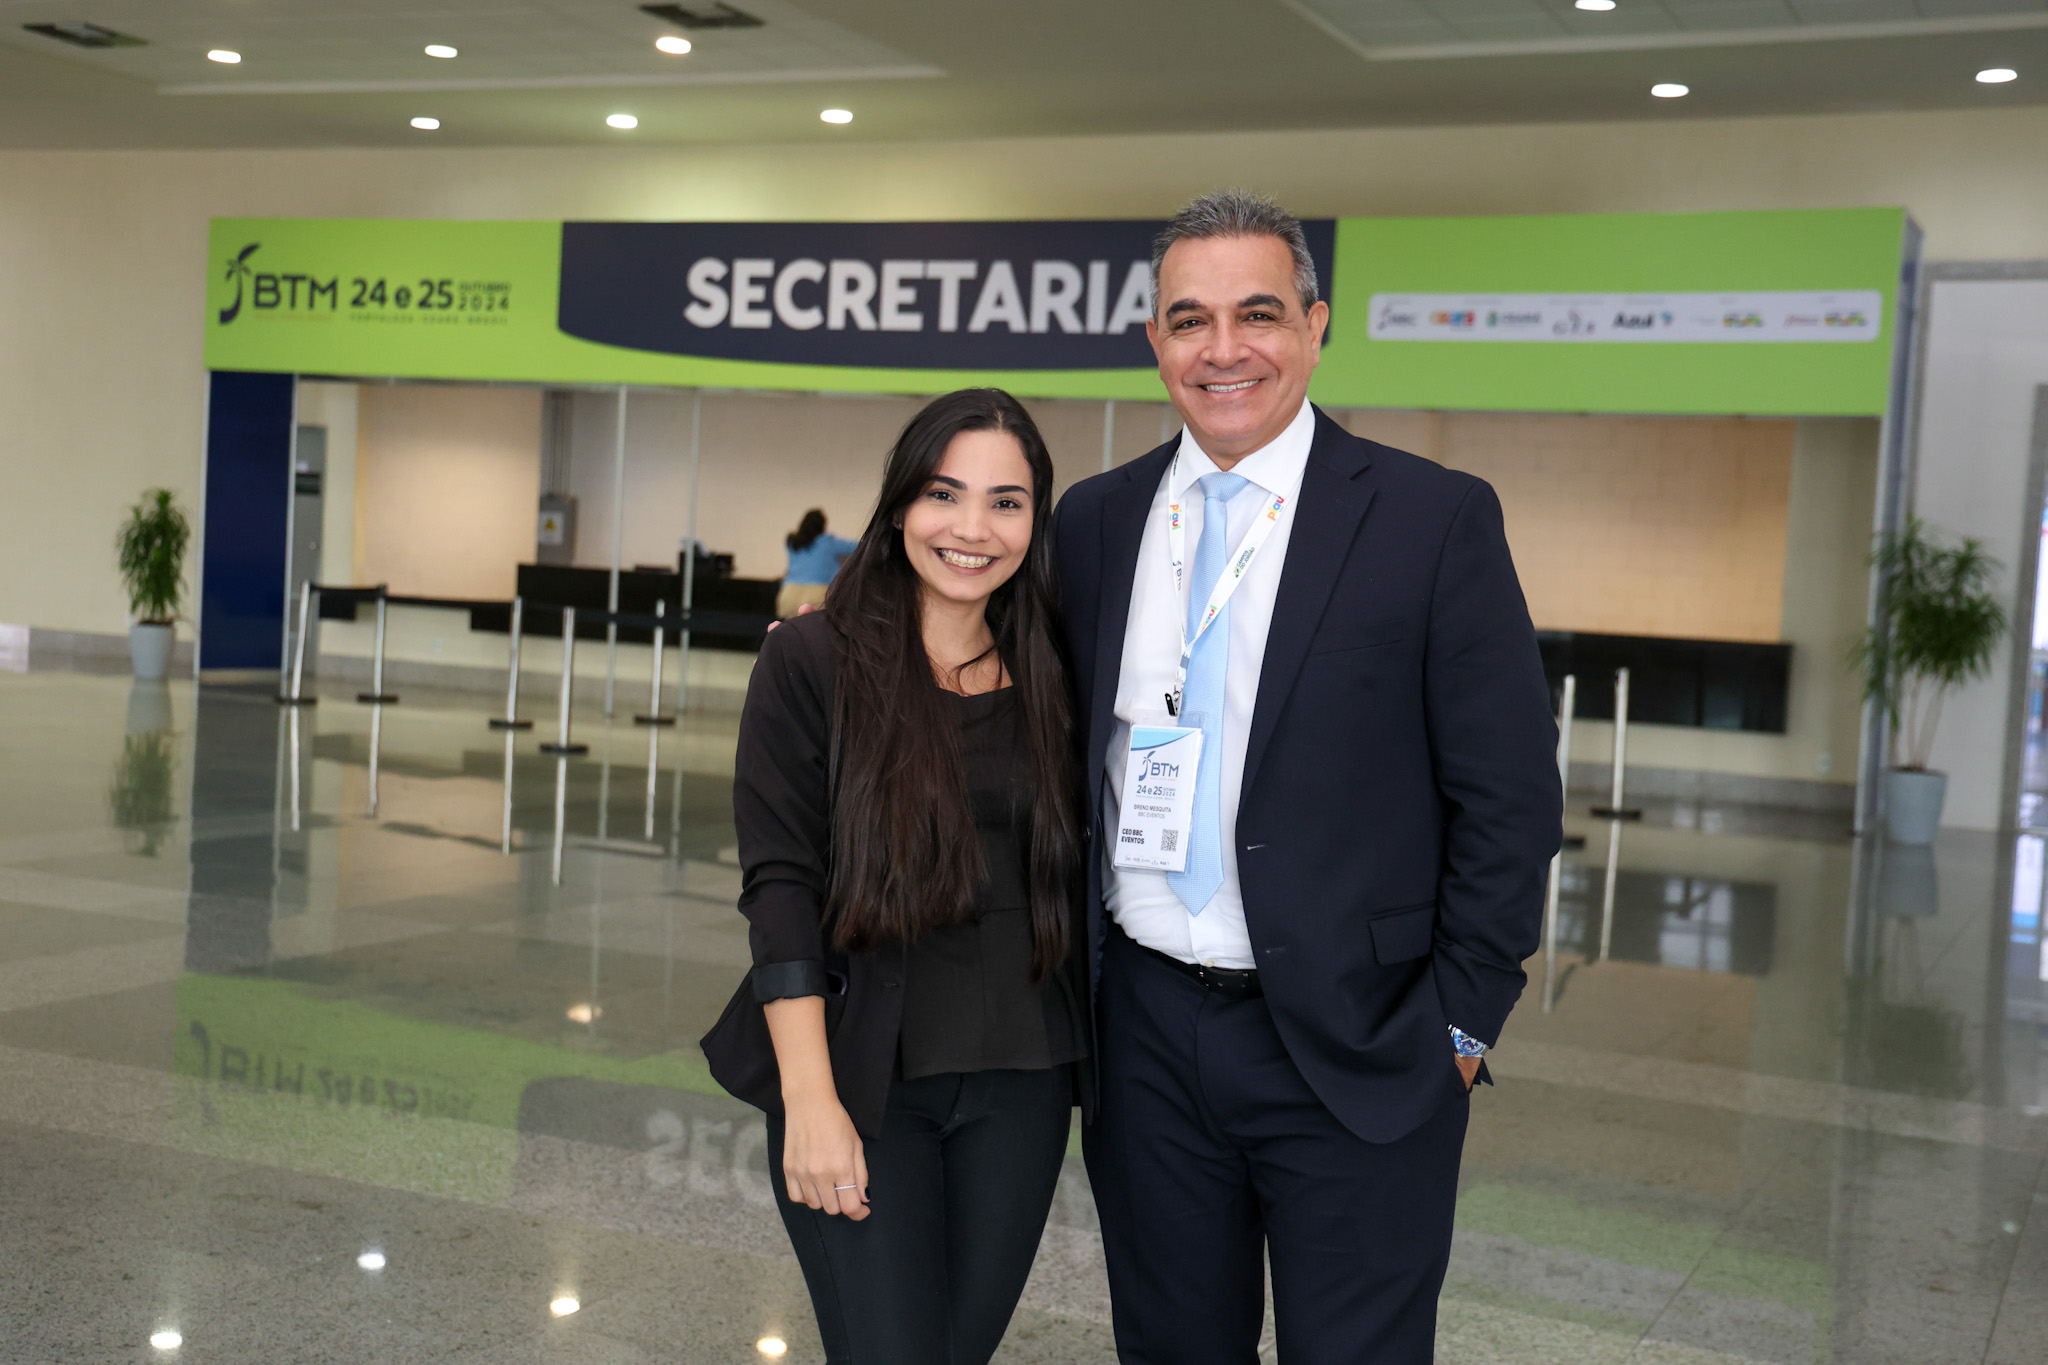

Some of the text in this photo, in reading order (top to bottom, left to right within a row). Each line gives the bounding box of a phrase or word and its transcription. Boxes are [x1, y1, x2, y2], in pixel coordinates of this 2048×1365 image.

[253, 274, 338, 311] BTM
[350, 278, 388, 310] 24
[394, 284, 412, 309] e
[417, 278, 455, 310] 25
[684, 257, 1150, 334] SECRETARIA
[457, 293, 510, 312] 2024
[1267, 496, 1285, 521] piau
[1151, 762, 1179, 777] BTM
[1136, 784, 1147, 794] 24
[1147, 787, 1153, 795] e
[1153, 786, 1163, 796] 25
[1150, 805, 1172, 813] MESQUITA
[1121, 836, 1145, 845] EVENTOS
[1132, 829, 1144, 837] BBC
